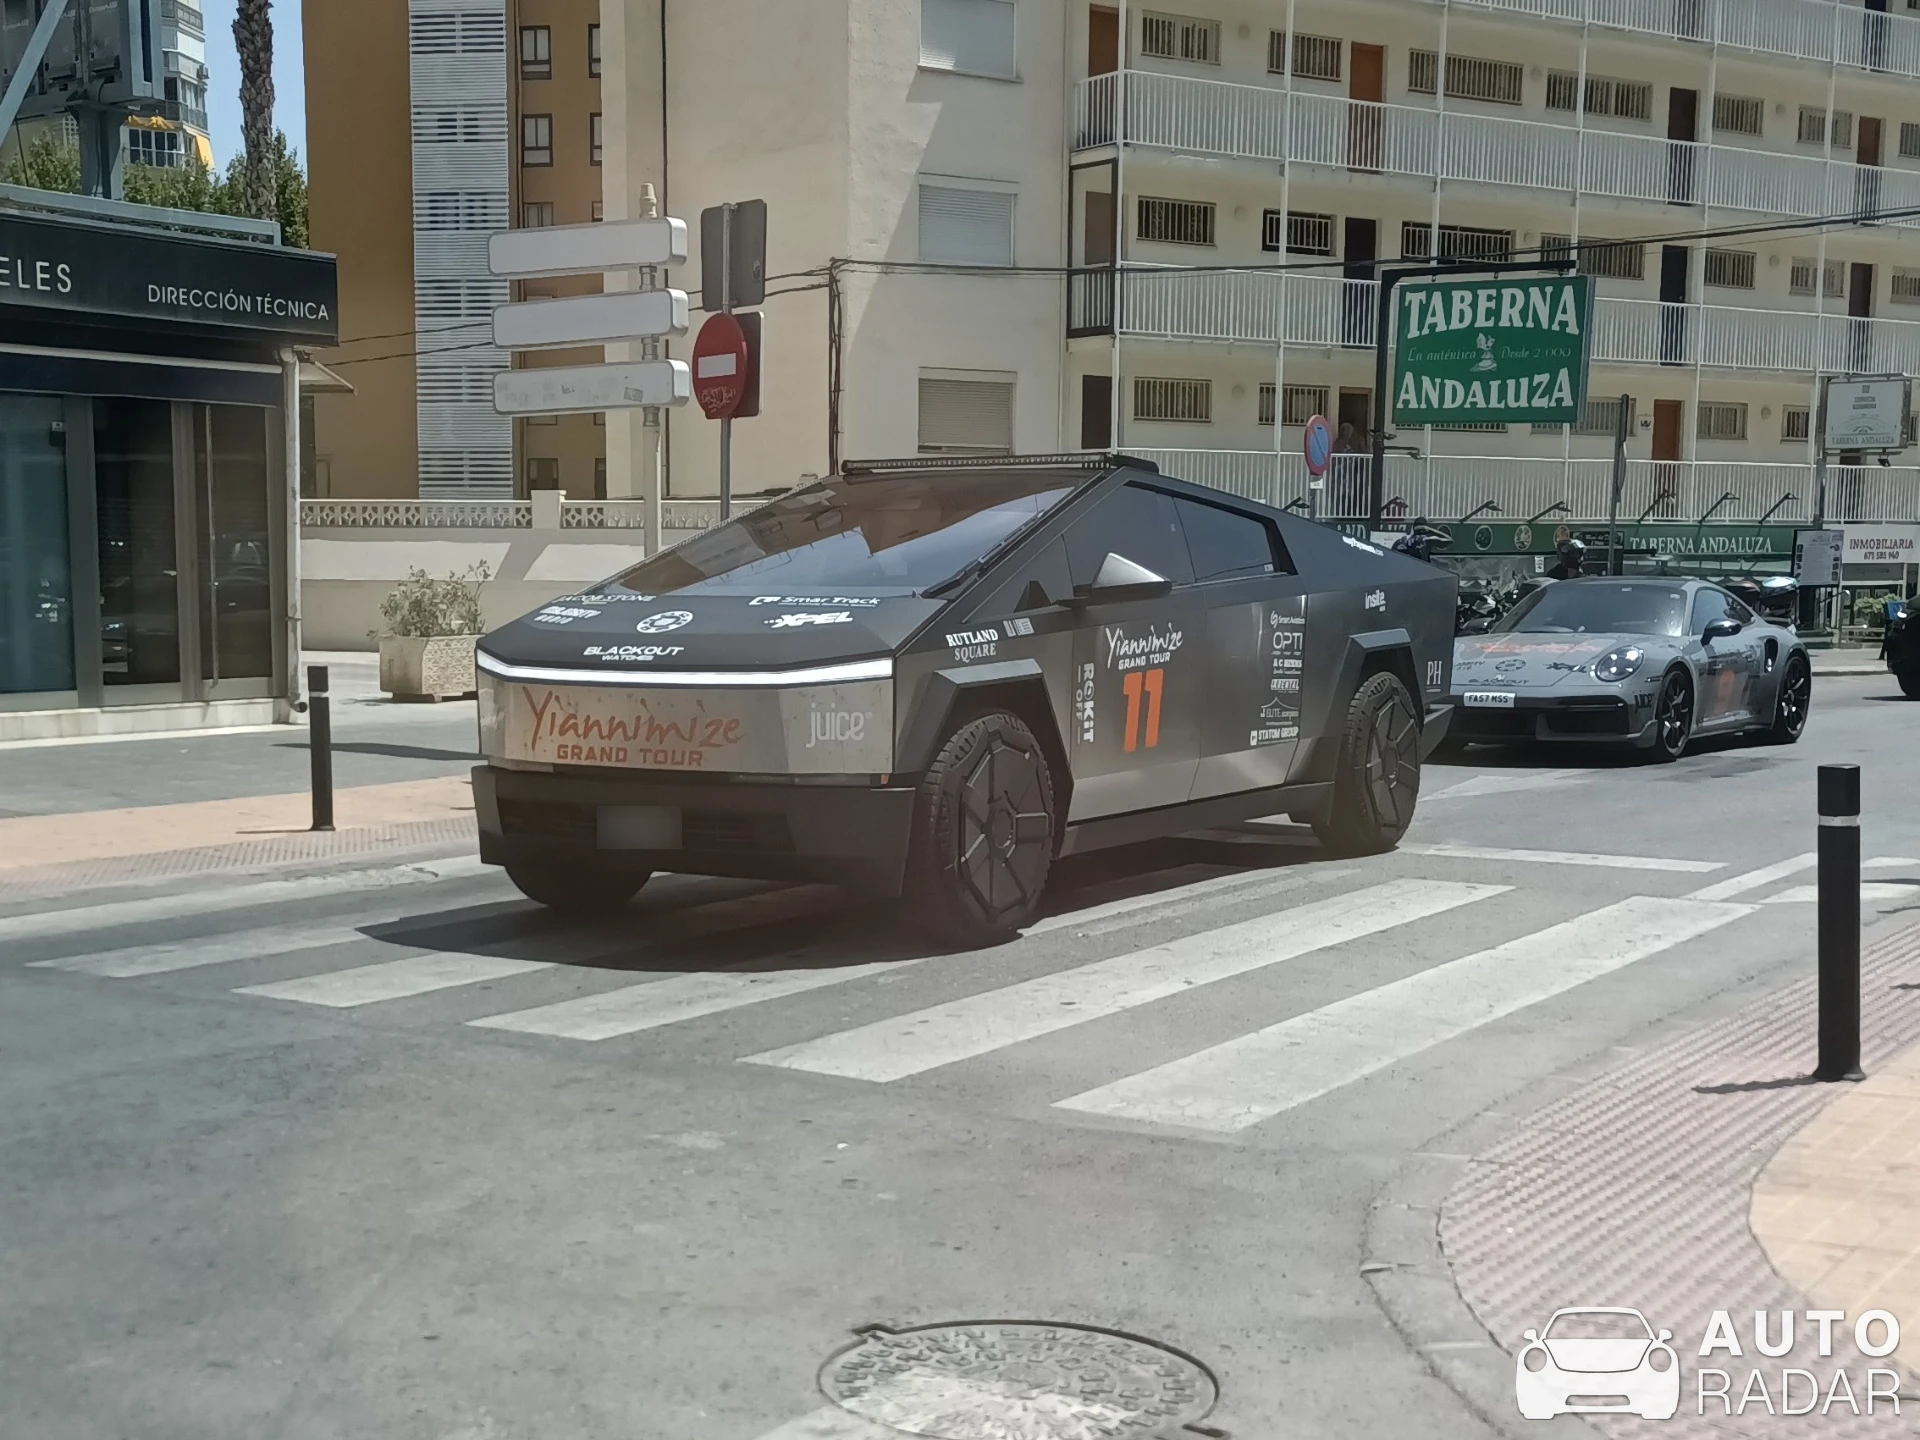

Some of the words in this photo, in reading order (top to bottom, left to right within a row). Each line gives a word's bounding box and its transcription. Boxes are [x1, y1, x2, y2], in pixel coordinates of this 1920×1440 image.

[148, 284, 251, 312] DIRECCIÓN
[256, 293, 329, 320] TÉCNICA
[1405, 285, 1580, 339] TABERNA
[1407, 346, 1423, 362] La
[1501, 345, 1530, 360] Desde
[1396, 367, 1574, 409] ANDALUZA
[1630, 537, 1695, 553] TABERNA
[1700, 537, 1772, 553] ANDALUZA
[1849, 538, 1914, 550] INMOBILIARIA
[771, 611, 854, 628] XPEL
[946, 629, 999, 647] RUTLAND
[1105, 622, 1184, 669] Yiannimize
[1273, 632, 1303, 650] OPTI
[583, 645, 684, 656] BLACKOUT
[955, 643, 997, 663] SQUARE
[1118, 656, 1147, 670] GRAND
[1149, 652, 1171, 665] TOUR
[1426, 660, 1443, 685] PH
[1123, 669, 1164, 753] 11
[805, 702, 865, 749] juice
[557, 743, 628, 763] GRAND
[639, 747, 704, 767] TOUR
